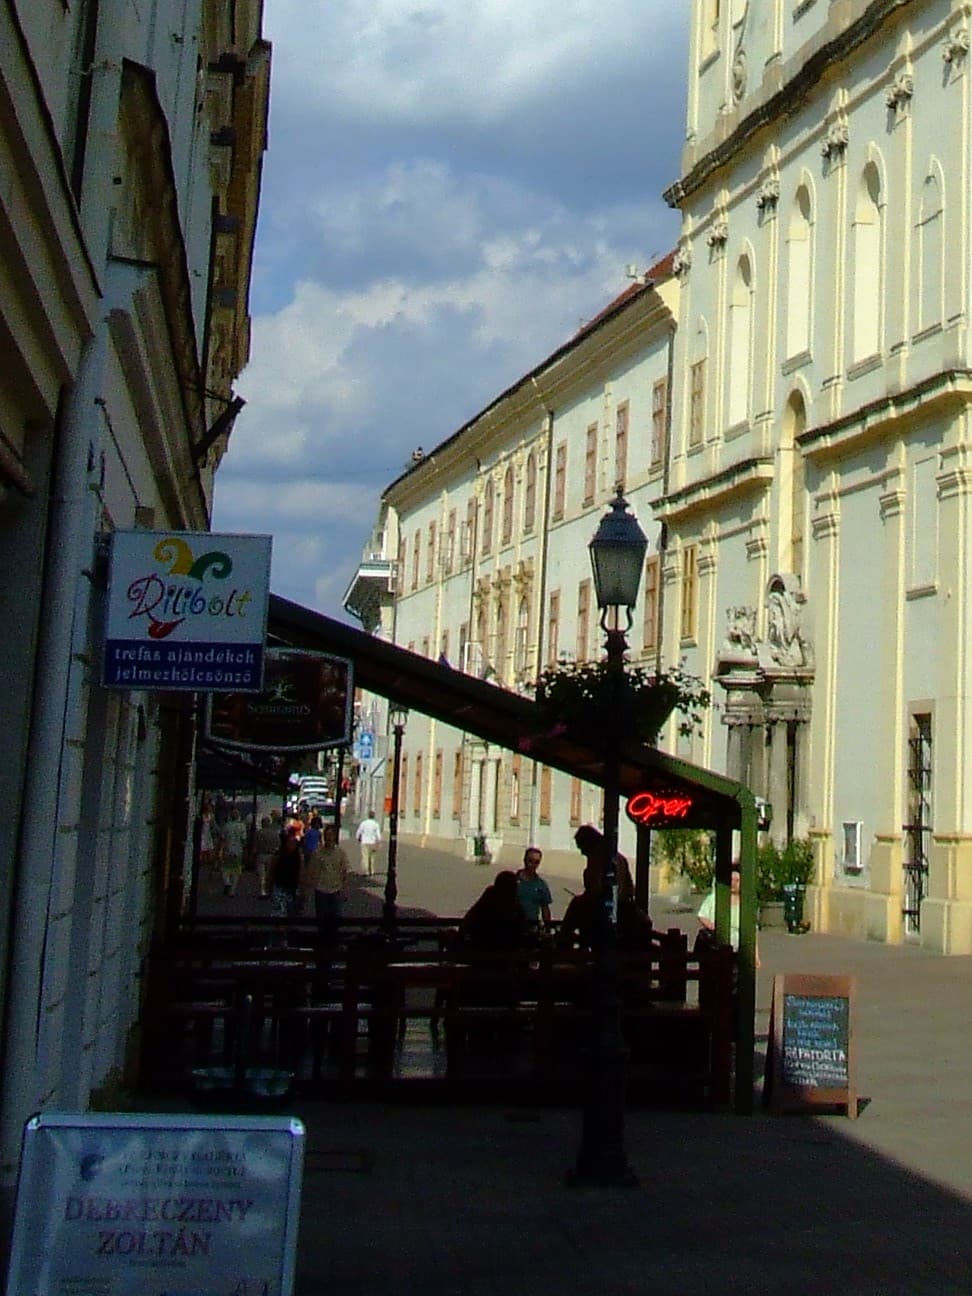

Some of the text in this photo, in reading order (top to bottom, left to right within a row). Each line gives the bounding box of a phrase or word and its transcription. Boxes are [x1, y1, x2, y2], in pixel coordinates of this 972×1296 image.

[127, 573, 252, 622] Dilibolt
[628, 793, 692, 821] Open
[97, 1225, 212, 1256] ZOLTÁN
